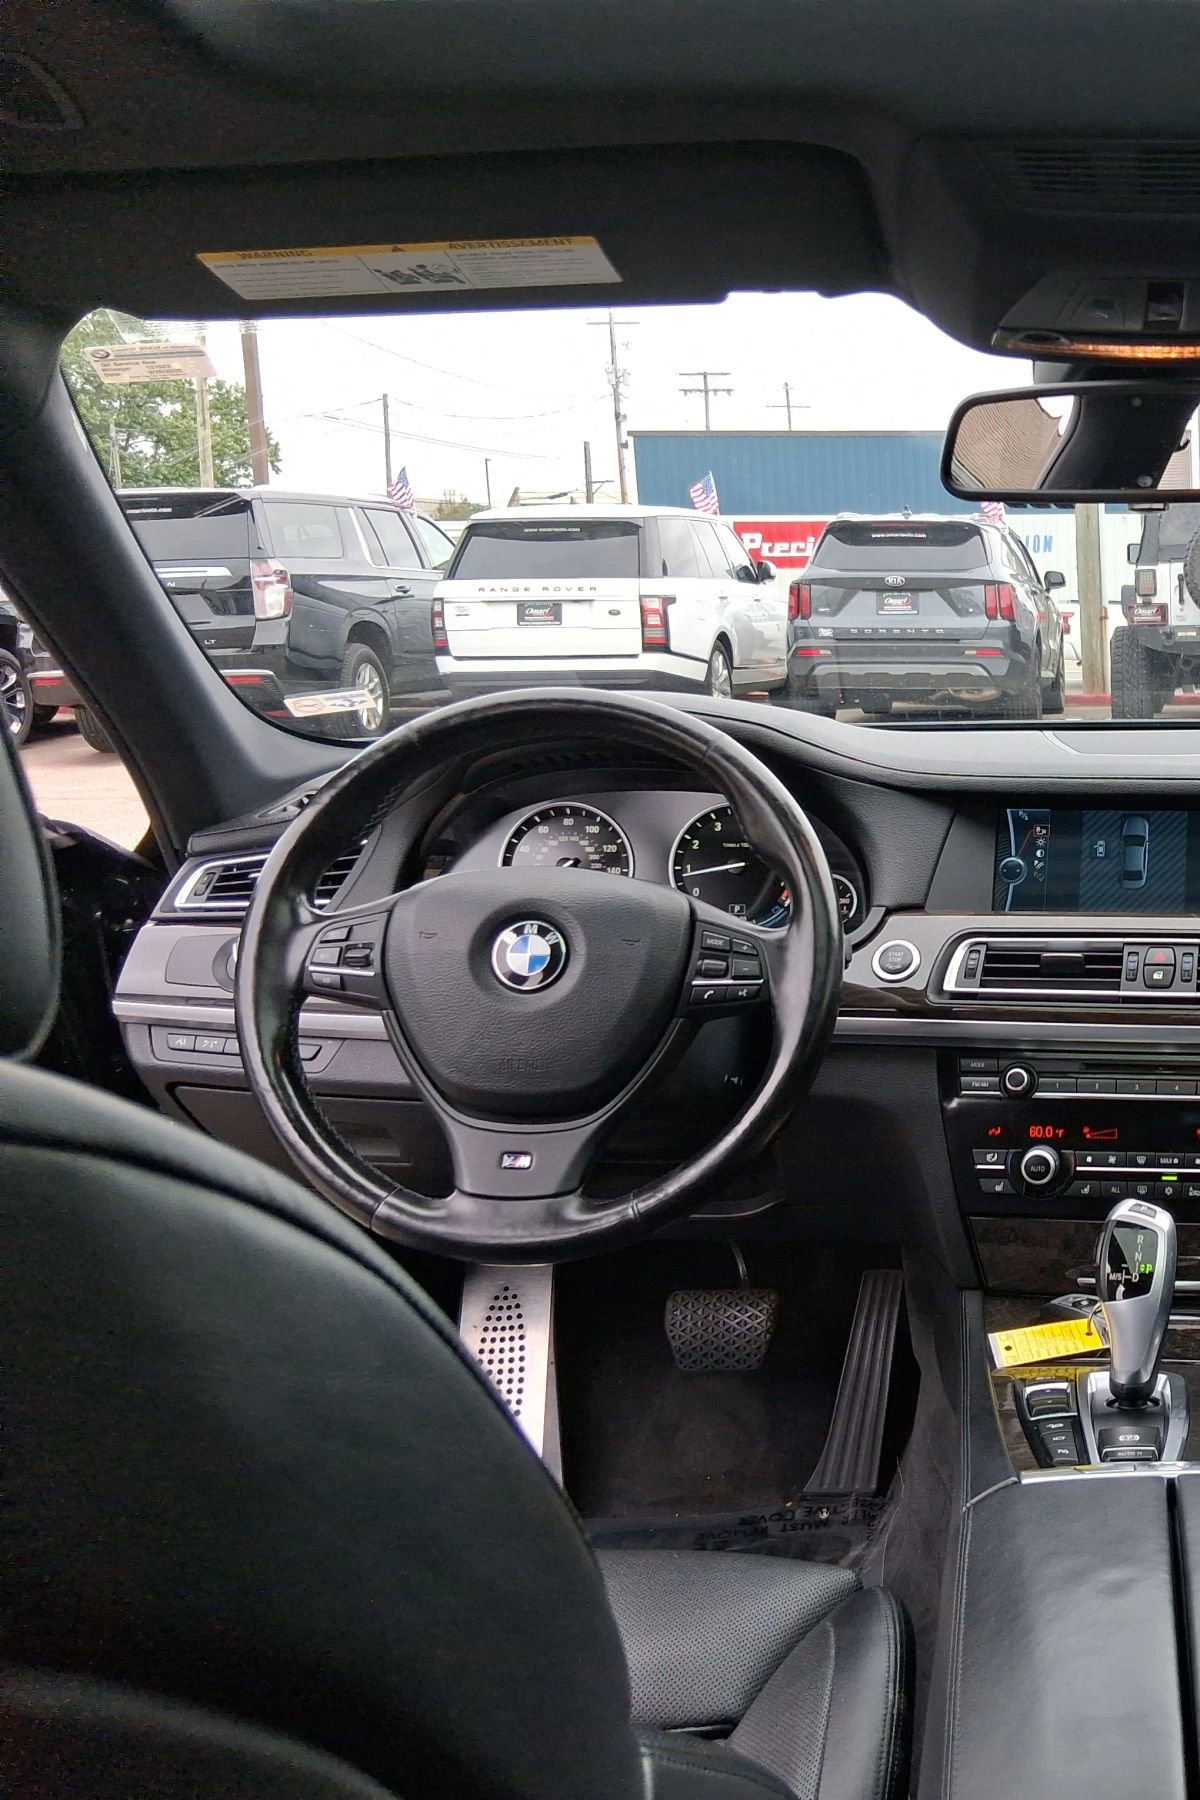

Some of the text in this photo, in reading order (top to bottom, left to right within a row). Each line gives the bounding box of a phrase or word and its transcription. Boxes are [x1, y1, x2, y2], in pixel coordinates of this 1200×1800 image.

[449, 239, 572, 249] AVERTISSEMENT
[238, 251, 312, 259] WARNING
[741, 533, 815, 557] Preci
[563, 818, 574, 826] 80
[714, 822, 722, 831] 3
[603, 845, 617, 853] 120
[692, 840, 700, 849] 2
[686, 865, 691, 873] 1
[693, 888, 700, 897] 0
[503, 924, 560, 945] BMW
[706, 938, 724, 946] MODE
[1029, 1126, 1053, 1138] 60.0
[1137, 1235, 1144, 1244] R
[1135, 1252, 1142, 1261] N
[1108, 1273, 1122, 1281] M/S
[1131, 1272, 1139, 1282] D
